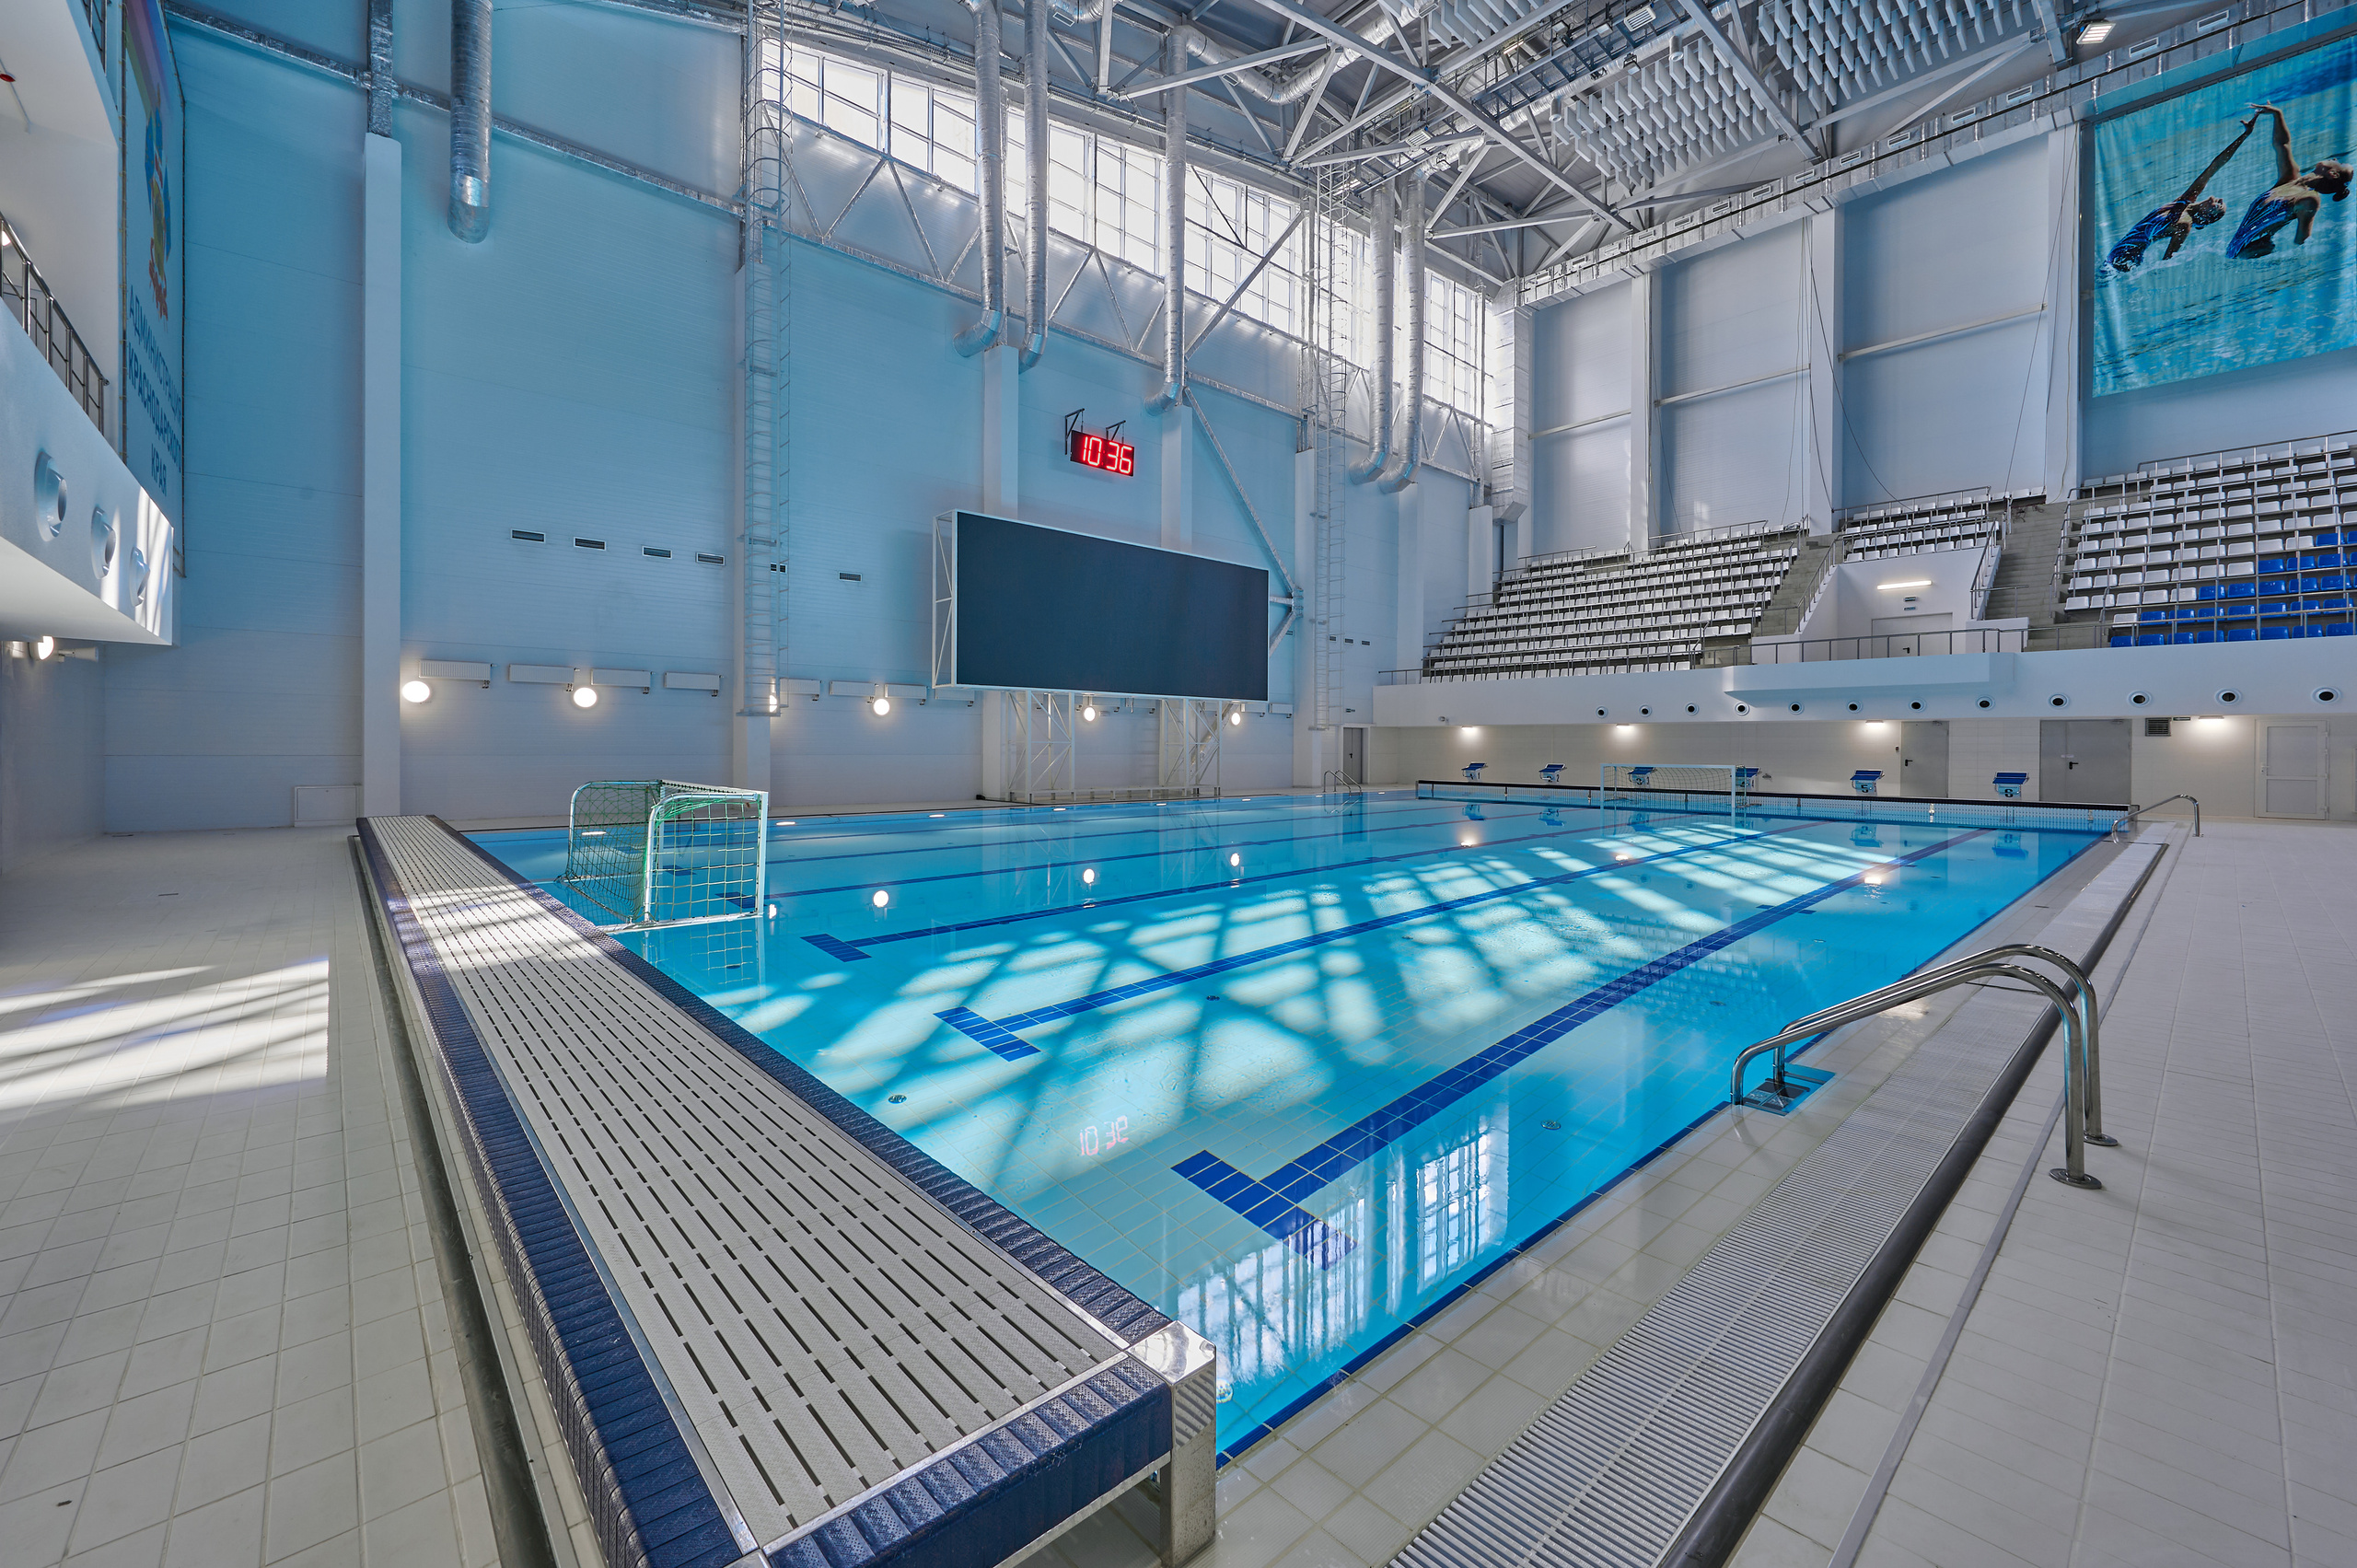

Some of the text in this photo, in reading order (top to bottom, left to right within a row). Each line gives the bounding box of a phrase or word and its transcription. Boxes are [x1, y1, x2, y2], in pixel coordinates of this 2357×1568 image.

[129, 284, 181, 428] АДМИНИСТРАЦИЯ
[129, 342, 182, 473] КРАСНОДАРСКОГО
[151, 443, 167, 497] КРАЯ
[1083, 436, 1132, 473] 10:36
[1860, 784, 1869, 794] 5
